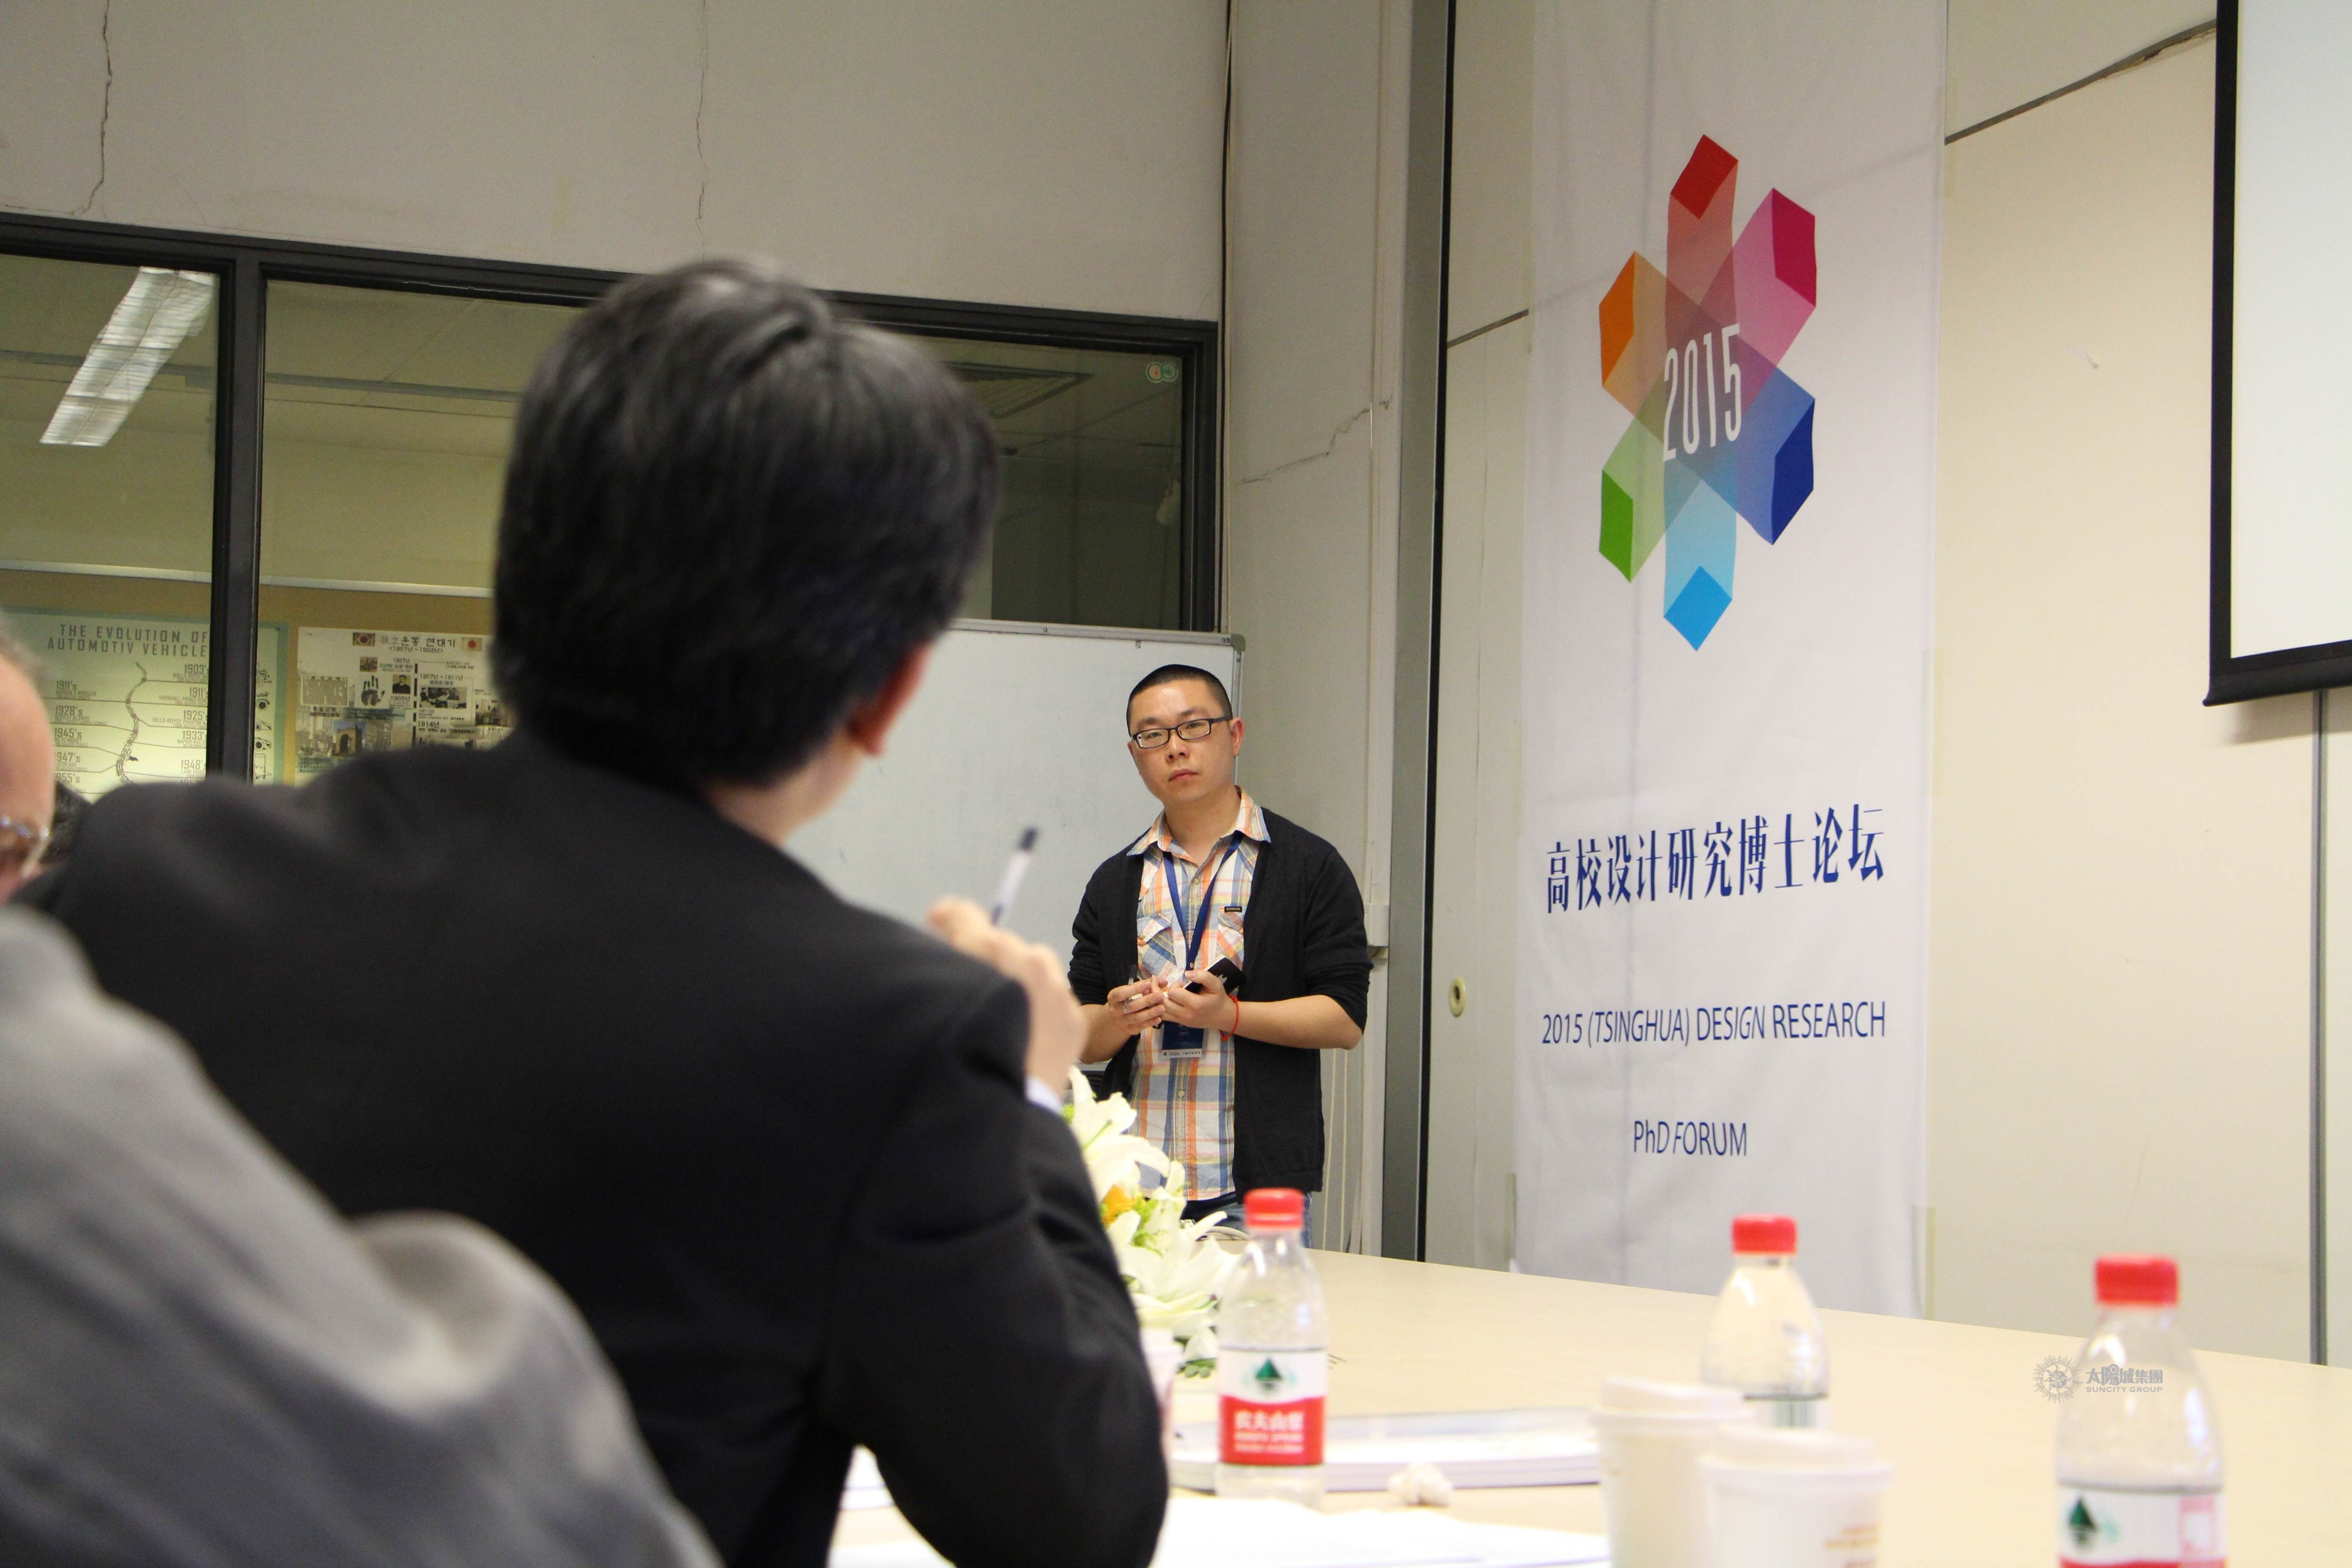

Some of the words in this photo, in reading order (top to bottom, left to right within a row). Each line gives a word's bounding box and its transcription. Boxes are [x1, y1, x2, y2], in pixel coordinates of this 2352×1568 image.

[1663, 323, 1741, 462] 2015
[60, 624, 86, 637] THE
[97, 626, 180, 642] EVOLUTION
[191, 632, 207, 643] OF
[426, 638, 455, 648] 연대기
[48, 637, 133, 653] AUTOMOTIV
[143, 643, 206, 657] VEHICLE
[56, 680, 77, 691] 1911's
[55, 705, 83, 716] 1928's
[54, 728, 82, 738] 1945's
[1547, 804, 1884, 914] 高校设计研究博士论坛
[1542, 1013, 1583, 1044] 2015
[1588, 1008, 1690, 1049] (TSINGHUA)
[1696, 1005, 1766, 1041] DESIGN
[1773, 1001, 1885, 1039] RESEARCH
[1633, 1120, 1669, 1154] PhD
[1672, 1122, 1747, 1156] FORUM
